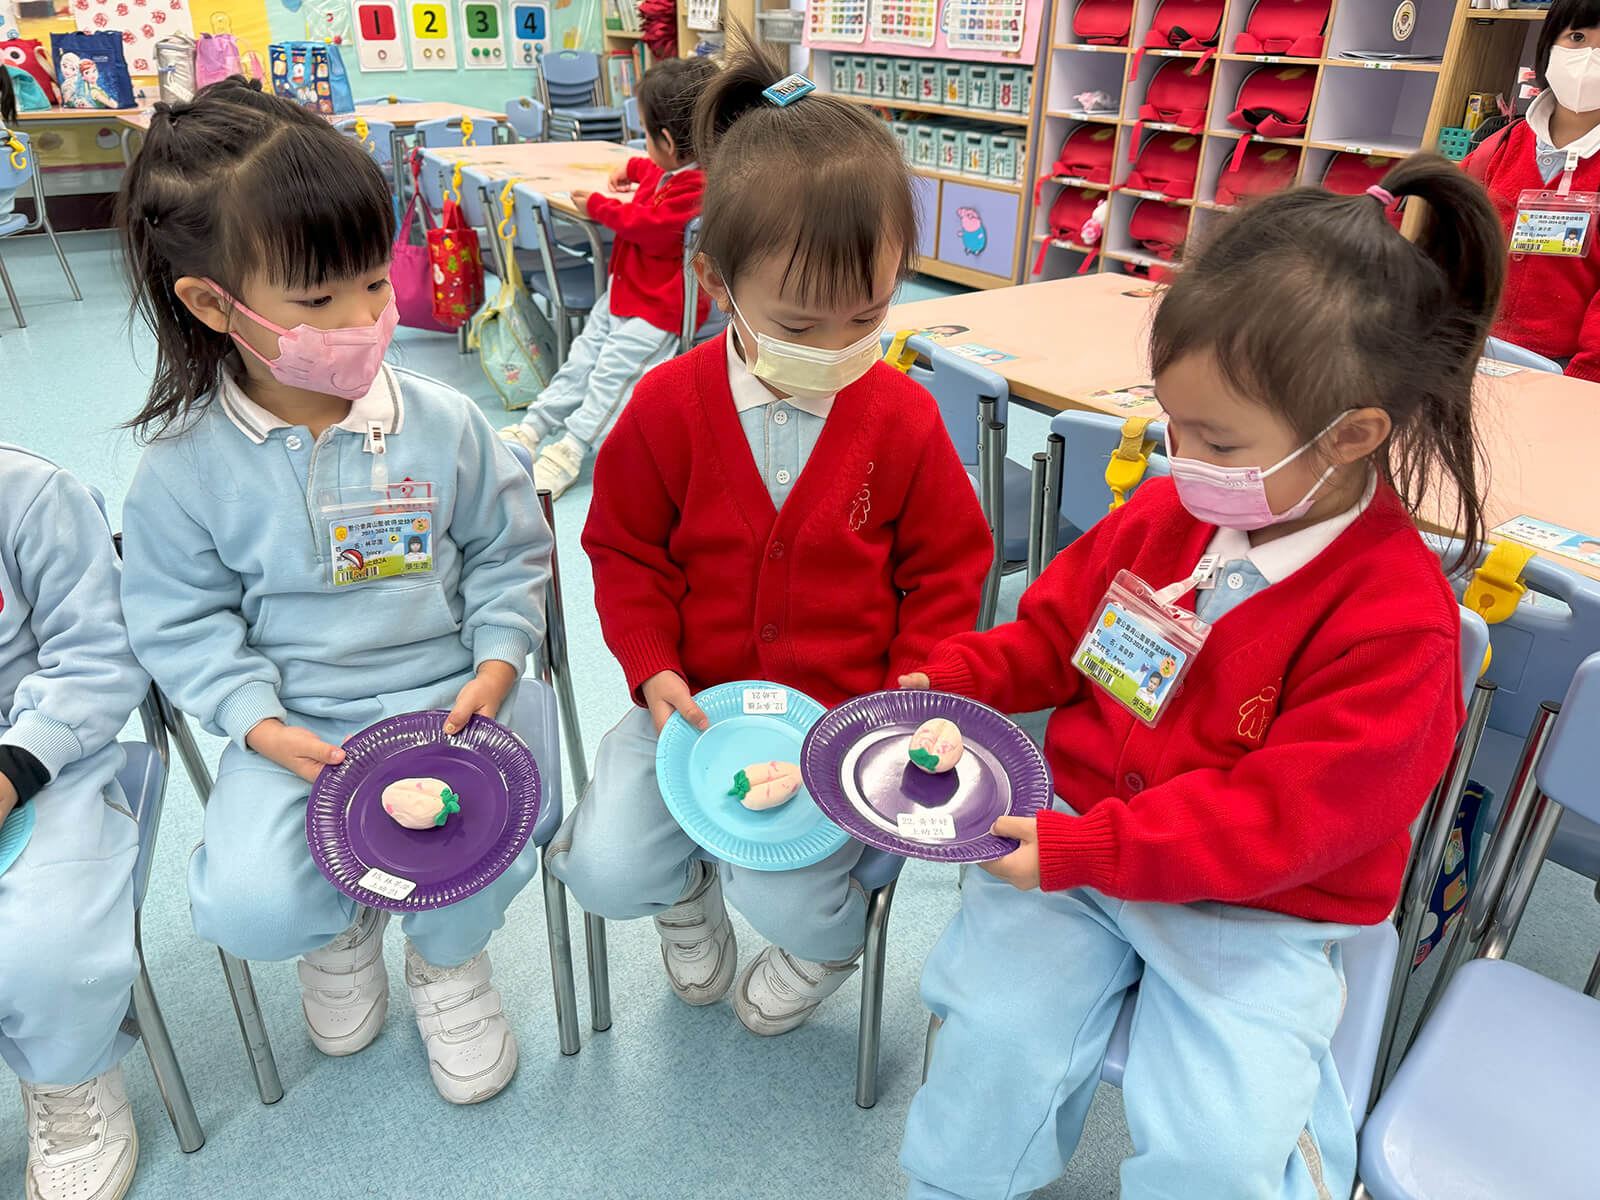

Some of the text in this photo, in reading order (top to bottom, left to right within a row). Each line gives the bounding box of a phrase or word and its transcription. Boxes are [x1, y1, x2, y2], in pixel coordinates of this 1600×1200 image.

[373, 10, 381, 35] 1
[423, 10, 438, 33] 2
[476, 10, 489, 33] 3
[523, 12, 537, 34] 4
[856, 73, 864, 90] 2
[877, 76, 886, 93] 3
[923, 79, 933, 97] 5
[947, 81, 958, 101] 6
[1001, 83, 1012, 106] 8
